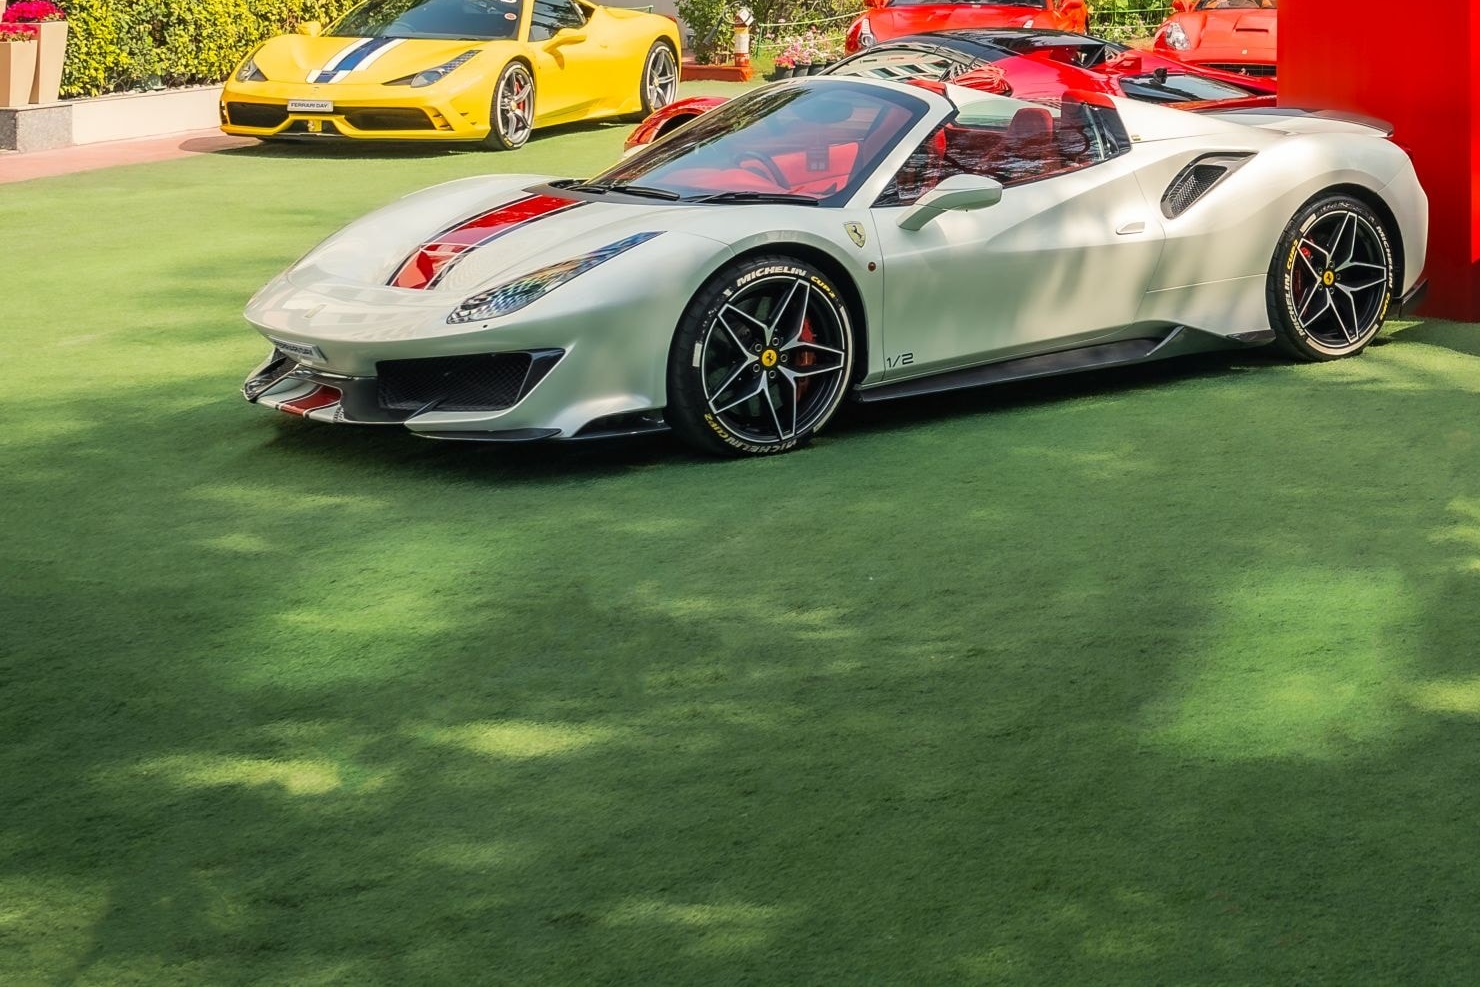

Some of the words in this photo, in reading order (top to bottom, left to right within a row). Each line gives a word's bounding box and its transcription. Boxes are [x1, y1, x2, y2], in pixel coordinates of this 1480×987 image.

[736, 266, 807, 287] MICHELIN
[1285, 273, 1306, 336] MICHELIN
[887, 353, 913, 367] 1/2
[724, 437, 797, 453] MICHELIN
